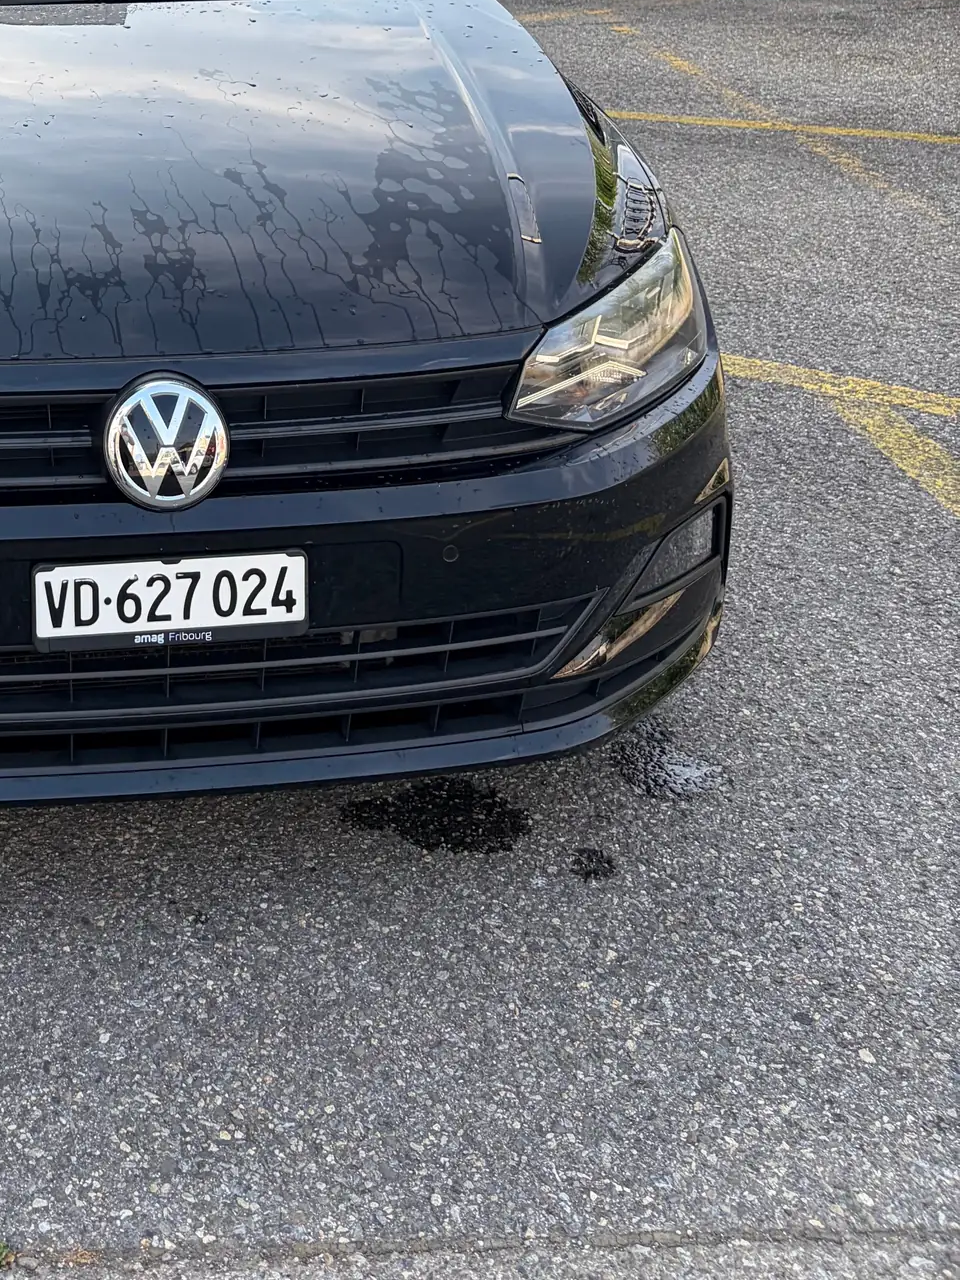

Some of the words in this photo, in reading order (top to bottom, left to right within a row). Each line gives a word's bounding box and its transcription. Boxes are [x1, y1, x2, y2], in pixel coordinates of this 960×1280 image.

[211, 566, 297, 618] 024
[134, 632, 165, 644] amag
[168, 629, 212, 643] Fribourg
